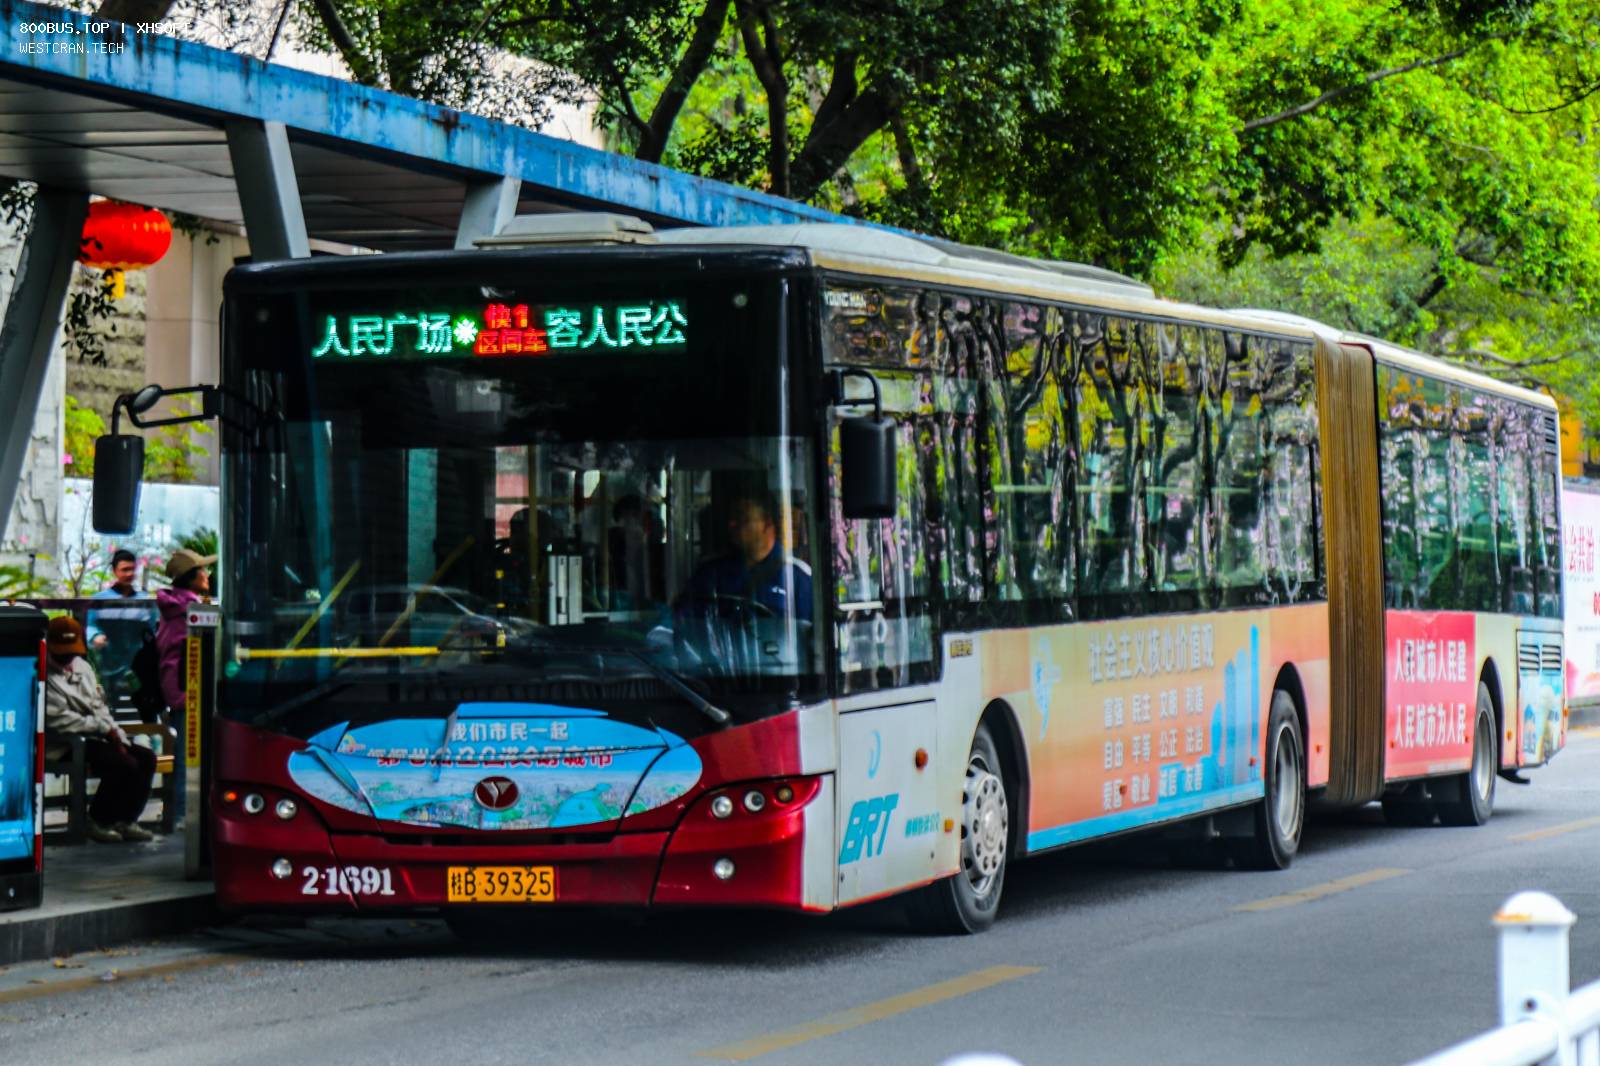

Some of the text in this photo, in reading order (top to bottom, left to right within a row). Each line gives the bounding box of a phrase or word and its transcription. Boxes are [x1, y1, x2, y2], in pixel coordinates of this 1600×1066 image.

[312, 304, 689, 357] 人民广场 容人民公
[838, 792, 900, 865] BRT
